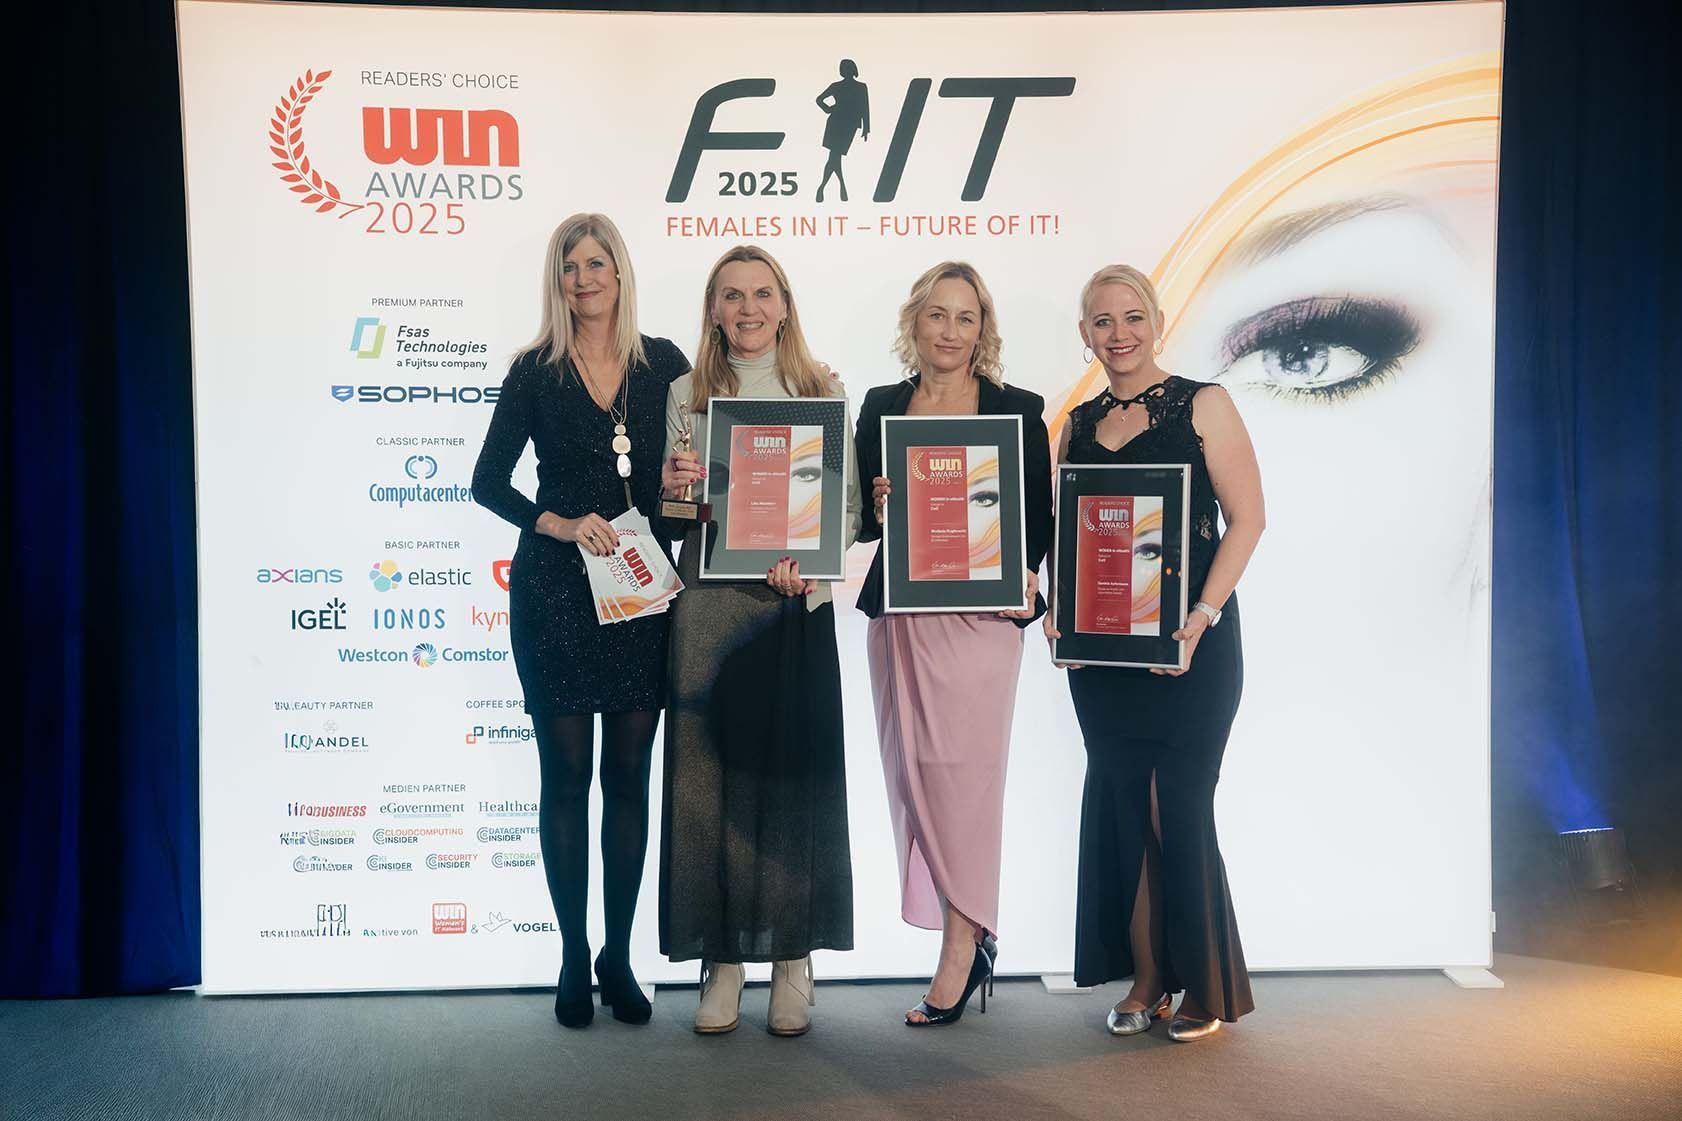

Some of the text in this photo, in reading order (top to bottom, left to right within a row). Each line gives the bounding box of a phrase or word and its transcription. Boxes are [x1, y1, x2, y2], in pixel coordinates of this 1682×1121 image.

[362, 71, 519, 89] READERS' CHOICE
[365, 172, 523, 200] AWARDS
[719, 171, 798, 196] 2025
[366, 202, 465, 234] 2025
[667, 216, 782, 237] FEMALES
[793, 217, 816, 236] IN
[828, 216, 848, 236] IT
[881, 216, 976, 236] FUTURE
[987, 215, 1019, 235] OF
[1031, 215, 1058, 234] IT!
[372, 298, 463, 307] PREMIUM PARTNER
[398, 326, 429, 337] Fsas
[397, 340, 487, 355] Technologies
[406, 358, 438, 370] Fujitsu
[441, 361, 487, 370] company
[358, 386, 501, 403] SOPHOS
[376, 437, 464, 448] CLASSIC PARTNER
[385, 541, 460, 549] BASIC PARTNER
[257, 569, 342, 583] axians
[409, 569, 471, 585] elastic
[291, 610, 346, 629] IGEL
[374, 608, 445, 629] IONOS
[338, 649, 408, 662] Westcon
[442, 648, 509, 662] Comstor
[330, 701, 373, 709] PARTNER
[466, 700, 503, 709] COFFEE
[383, 784, 466, 793] MEDIEN PARTNER
[380, 803, 464, 813] eGovernment
[489, 834, 521, 842] INSIDER
[504, 860, 536, 868] INSIDER
[513, 923, 557, 932] VOGEL
